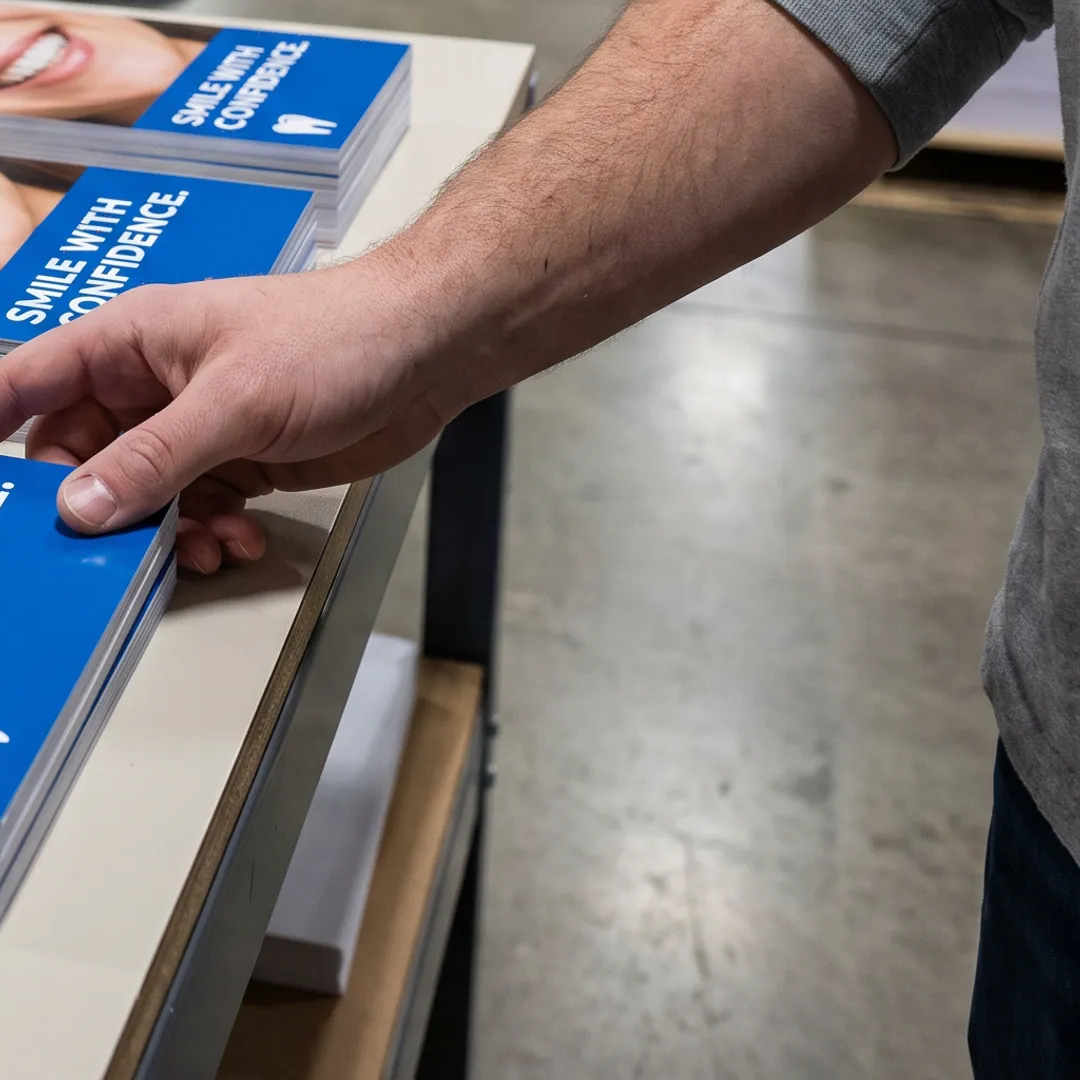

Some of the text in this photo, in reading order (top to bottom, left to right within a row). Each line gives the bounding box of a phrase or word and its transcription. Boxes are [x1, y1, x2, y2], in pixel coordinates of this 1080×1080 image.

[171, 45, 265, 127] SMILE WITH
[6, 197, 133, 326] SMILE WITH
